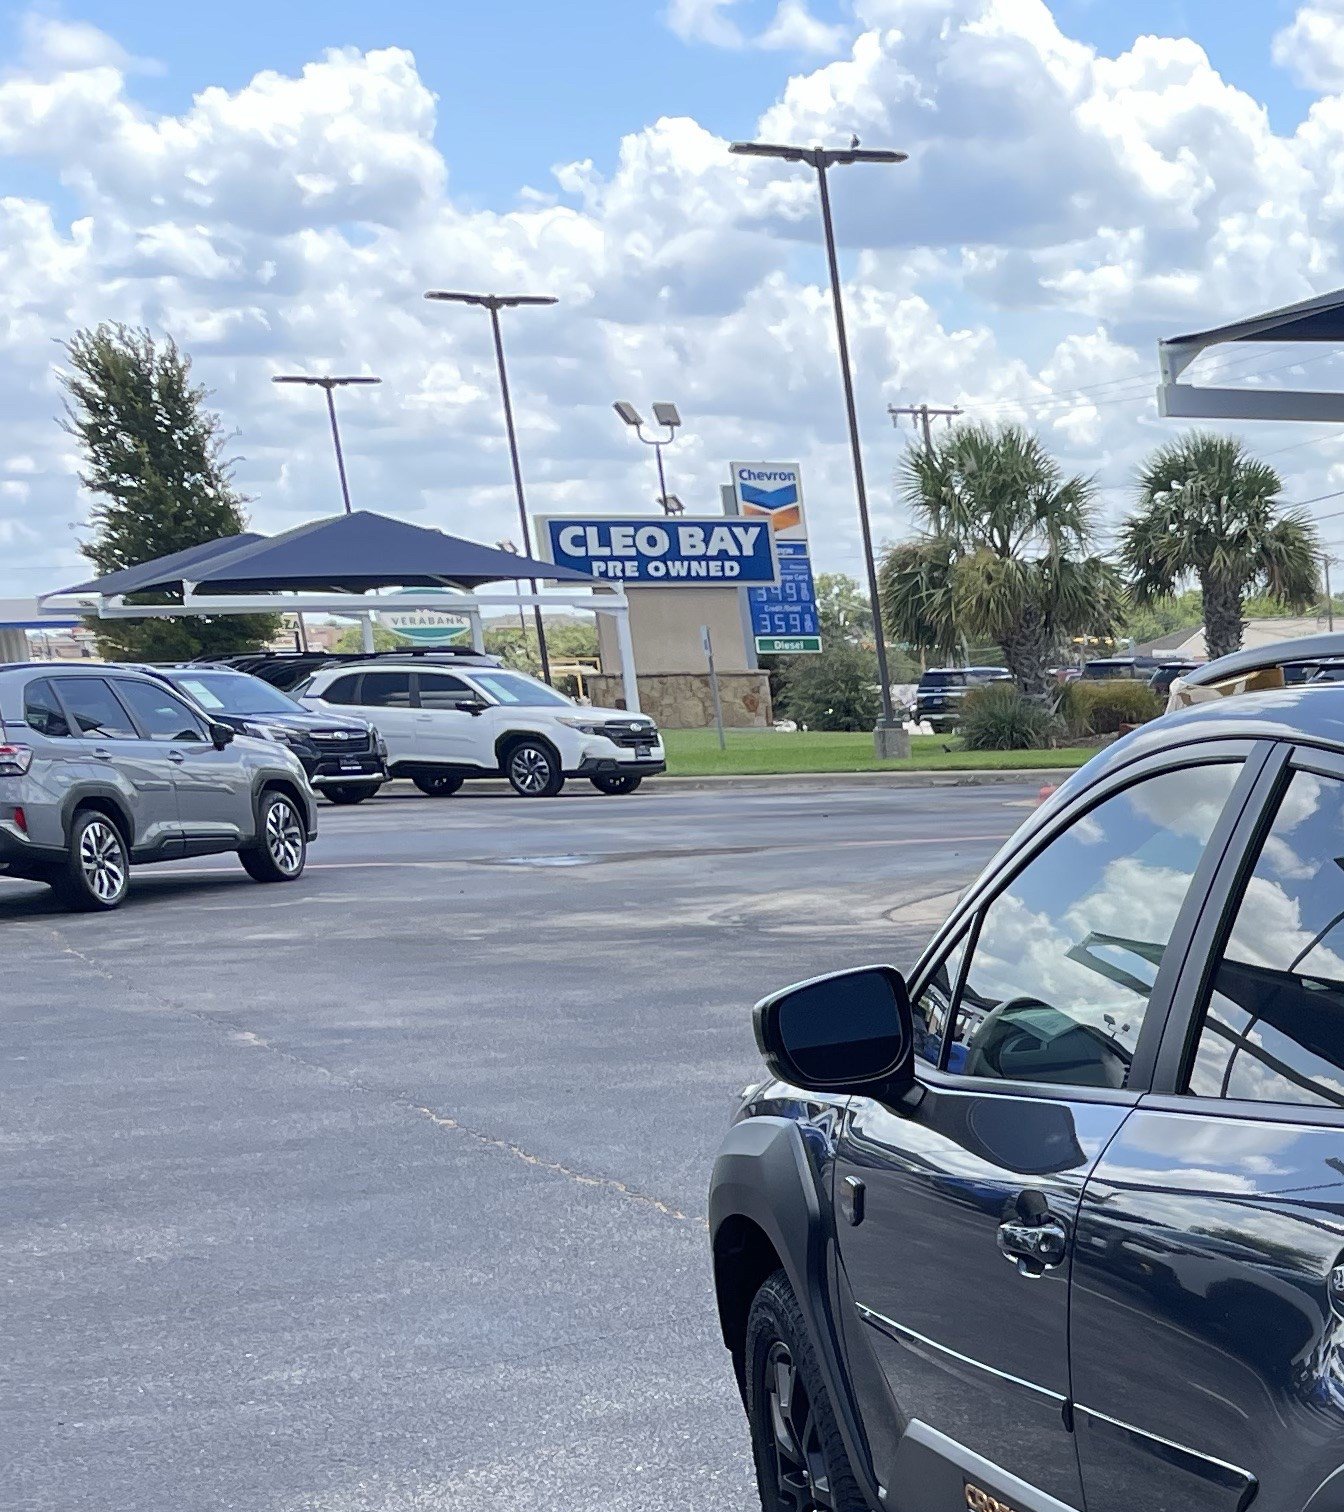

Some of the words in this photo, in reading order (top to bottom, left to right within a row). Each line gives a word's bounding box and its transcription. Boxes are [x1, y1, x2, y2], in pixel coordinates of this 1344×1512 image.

[739, 469, 796, 481] Chevron
[559, 526, 670, 557] CLEO
[678, 526, 761, 557] BAY
[592, 561, 639, 578] PRE
[647, 561, 740, 577] OWNED
[391, 617, 464, 626] VERABANK
[774, 641, 804, 649] Diesel
